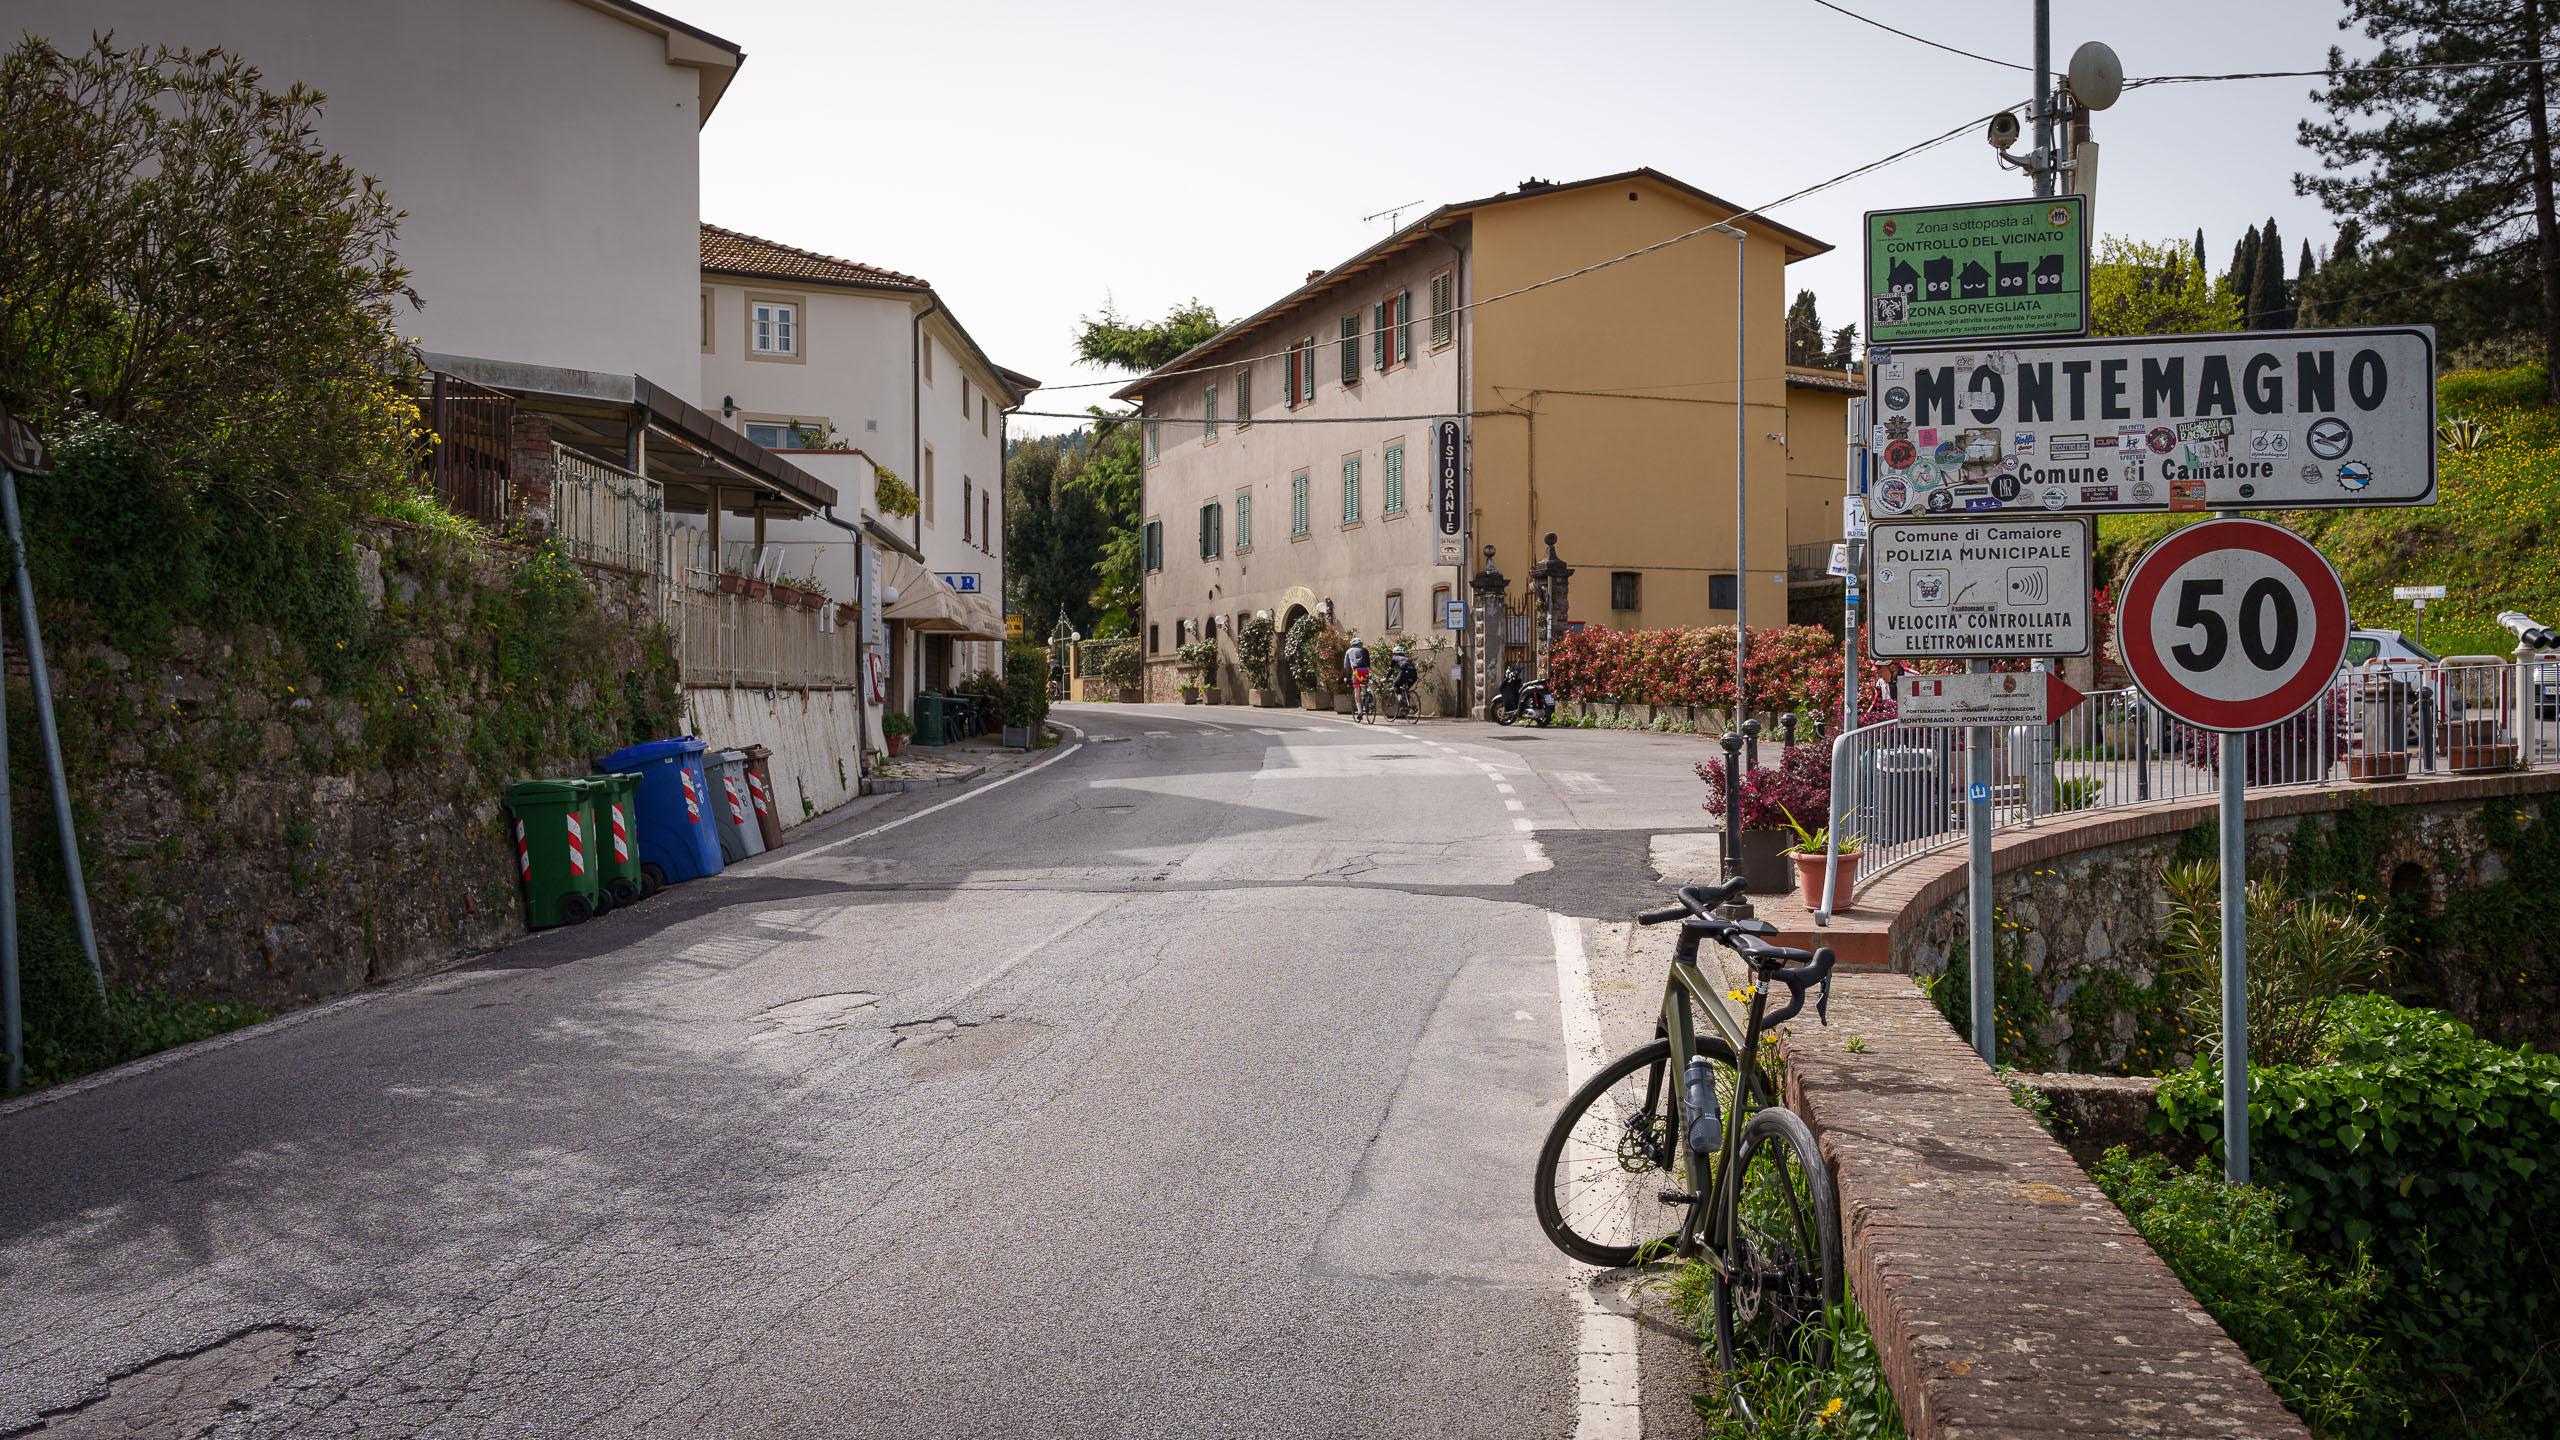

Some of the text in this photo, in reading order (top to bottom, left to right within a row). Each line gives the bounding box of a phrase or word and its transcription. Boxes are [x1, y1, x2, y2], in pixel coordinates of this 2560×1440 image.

[1916, 222, 1948, 234] Zona
[1952, 215, 2018, 231] sottoposta
[2022, 214, 2033, 226] al
[1887, 231, 2064, 253] CONTROLLO DEL VICINATO
[1909, 300, 2042, 318] ZONA SORVEGLIATA
[1909, 319, 1943, 327] segnalano
[1960, 316, 1982, 324] attività
[2054, 311, 2077, 319] Polizia
[1929, 327, 1950, 335] report
[1991, 322, 2015, 331] activity
[2036, 321, 2058, 329] police
[1914, 348, 2388, 427] MONTEMAGNO
[1444, 423, 1456, 533] RISTORANTE
[2019, 462, 2109, 485] Comune
[2161, 457, 2274, 481] Camaiore
[1848, 509, 1867, 526] 14
[1895, 527, 2062, 543] Comune di Camaiore
[1886, 545, 2071, 562] POLIZIA MUNICIPALE
[1888, 612, 2072, 631] VELOCITA' CONTROLLATA
[2170, 576, 2299, 673] 50
[1906, 633, 2054, 650] ELETTRONICAMENTE
[1961, 715, 2023, 723] PONTEMAZZORI
